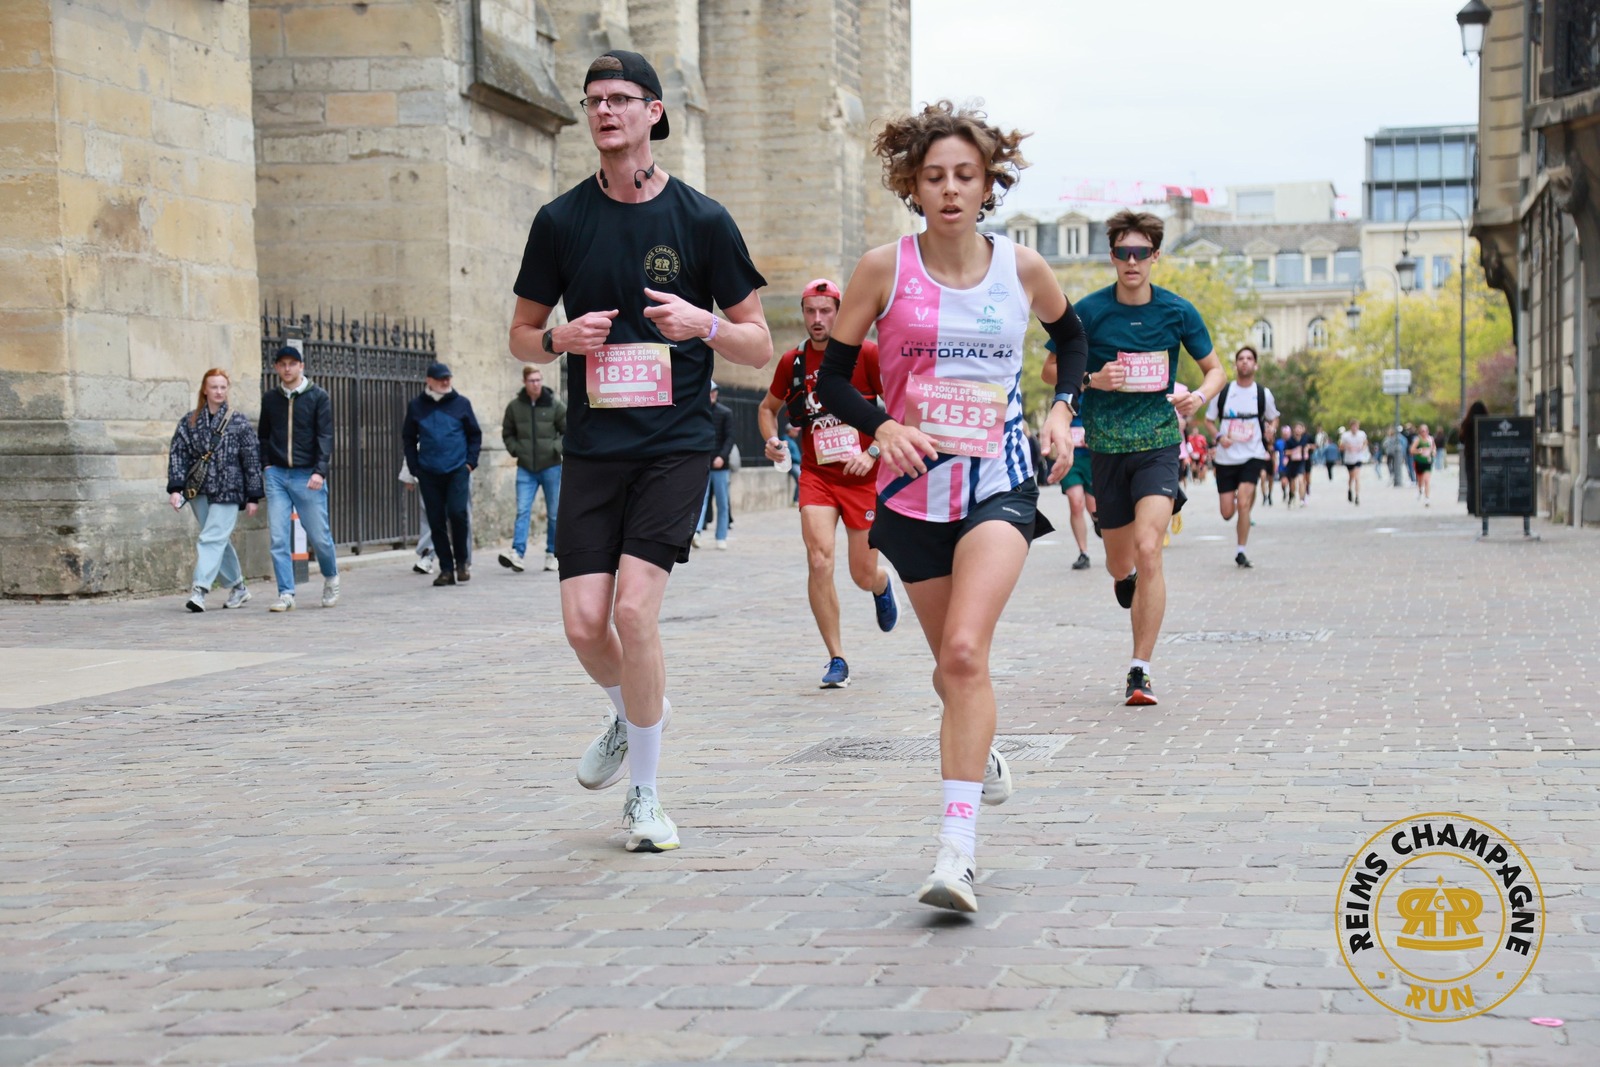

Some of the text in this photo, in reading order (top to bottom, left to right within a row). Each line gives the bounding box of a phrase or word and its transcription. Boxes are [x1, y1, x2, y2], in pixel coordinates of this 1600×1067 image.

[901, 347, 988, 358] LITTORAL
[596, 364, 661, 382] 18321
[1124, 364, 1165, 376] 18915
[920, 383, 932, 391] LES
[935, 385, 957, 394] 10KM
[932, 392, 952, 400] FOND
[967, 396, 992, 404] FORME
[917, 402, 997, 427] 14533
[819, 435, 855, 450] 21186
